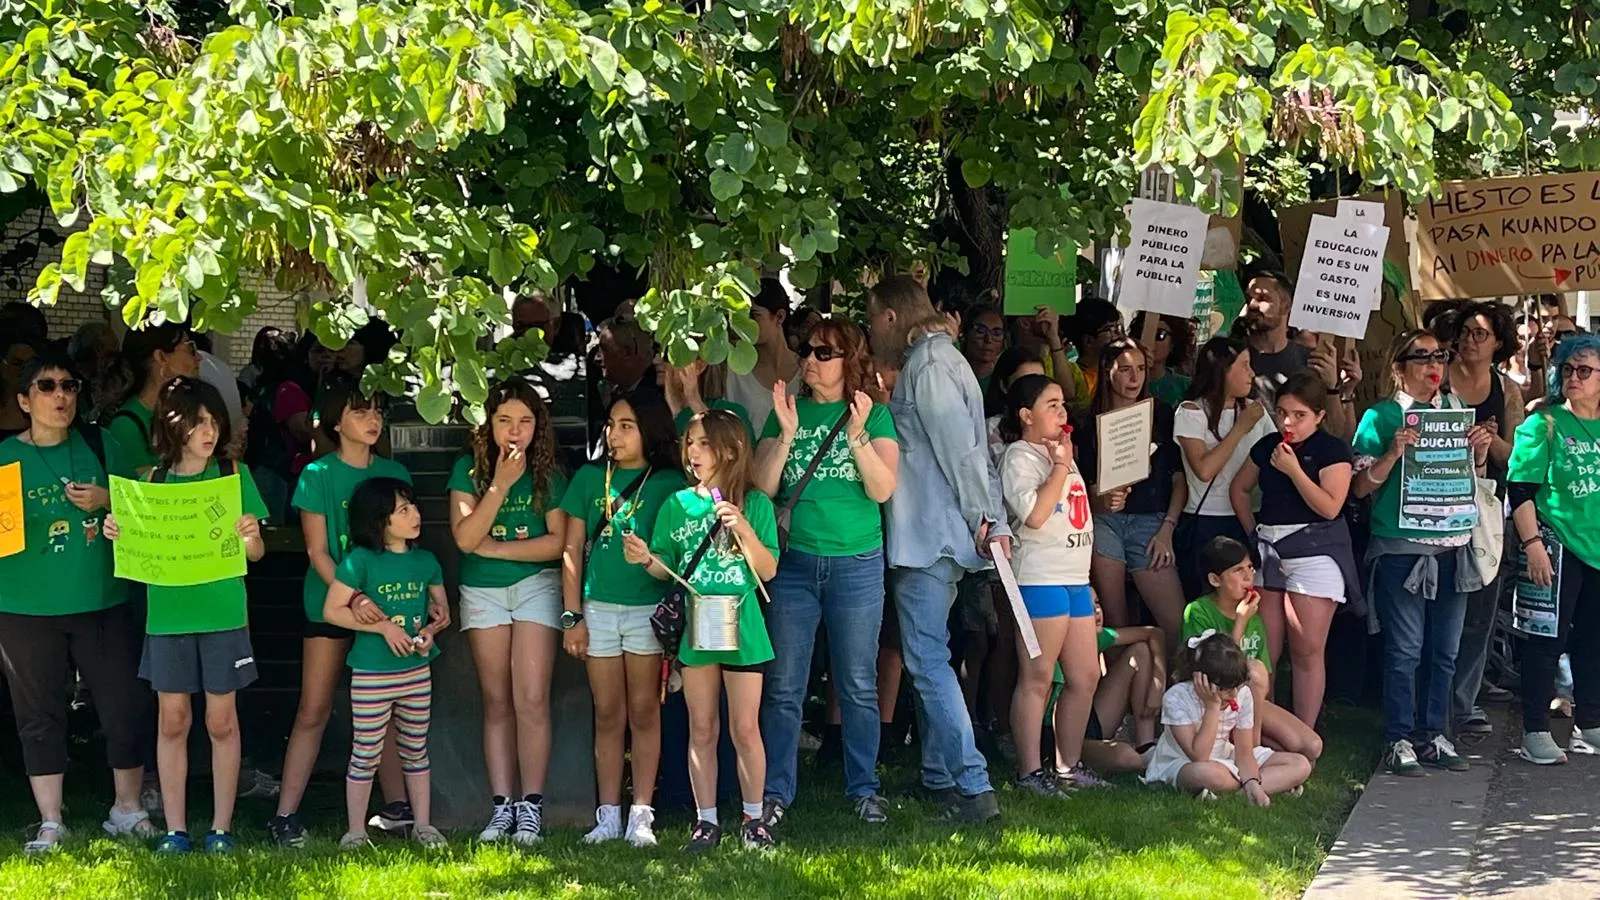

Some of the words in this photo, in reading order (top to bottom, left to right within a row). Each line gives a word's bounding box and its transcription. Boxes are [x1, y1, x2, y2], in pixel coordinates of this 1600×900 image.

[1429, 186, 1531, 218] HESTO
[1541, 183, 1575, 204] ES
[1355, 208, 1366, 217] LA
[1147, 224, 1189, 239] DINERO
[1344, 228, 1358, 239] LA
[1429, 223, 1490, 245] PASA
[1502, 216, 1596, 237] KUANDO
[1141, 238, 1189, 254] PÚBLICO
[1314, 239, 1379, 258] EDUCACIÓN
[1139, 254, 1168, 267] PARA
[1170, 260, 1185, 269] LA
[1466, 247, 1533, 271] DINERO
[1541, 243, 1566, 263] PA
[1574, 240, 1600, 260] LA
[1317, 256, 1334, 266] NO
[1336, 260, 1351, 270] ES
[1353, 262, 1370, 273] UN
[1575, 258, 1600, 282] PÚ
[1136, 268, 1182, 285] PÚBLICA
[1320, 272, 1360, 289] GASTO,
[1316, 289, 1330, 299] ES
[1333, 291, 1357, 305] UNA
[1302, 303, 1361, 321] INVERSIÓN
[1425, 421, 1465, 433] HUELGA
[1577, 464, 1595, 476] DE
